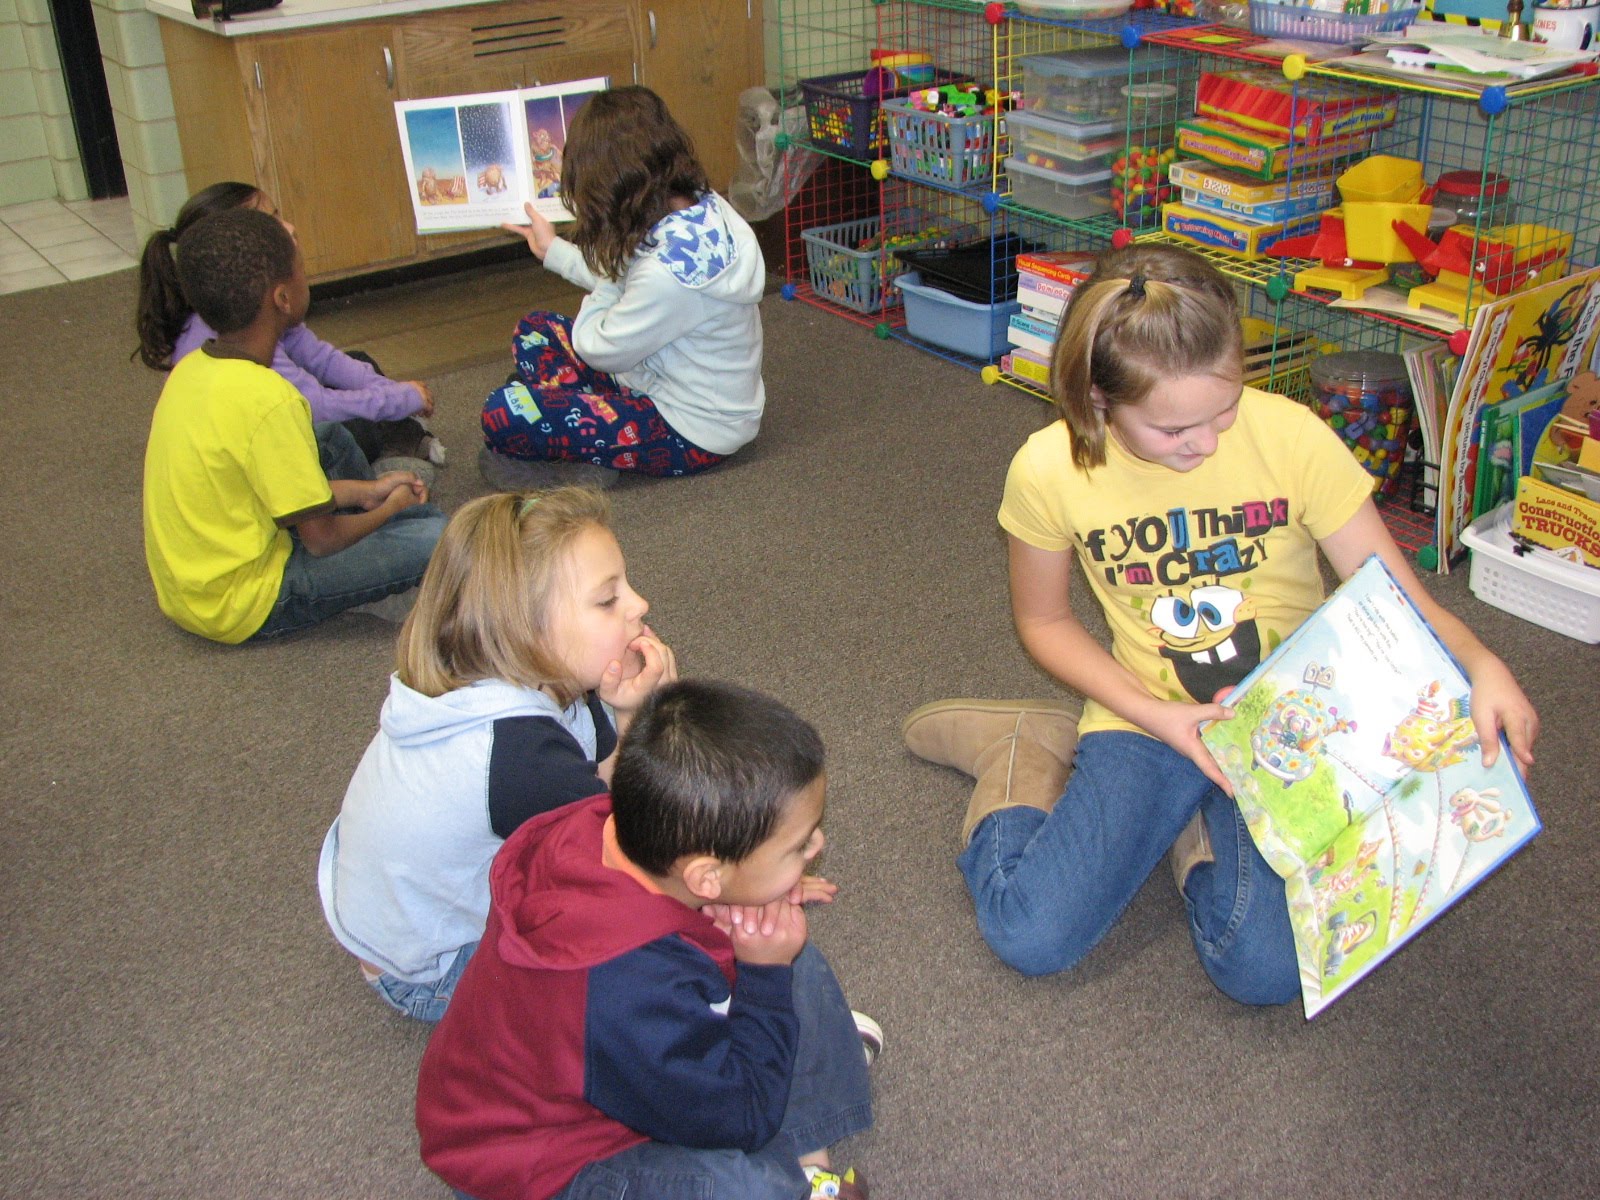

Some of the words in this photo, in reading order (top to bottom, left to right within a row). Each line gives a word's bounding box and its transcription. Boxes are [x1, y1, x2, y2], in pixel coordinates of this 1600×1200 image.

[1519, 502, 1600, 543] Constructio
[1536, 496, 1555, 505] Lace
[1557, 502, 1572, 511] and
[1574, 507, 1597, 525] Trace
[1522, 515, 1600, 558] TRUCKS
